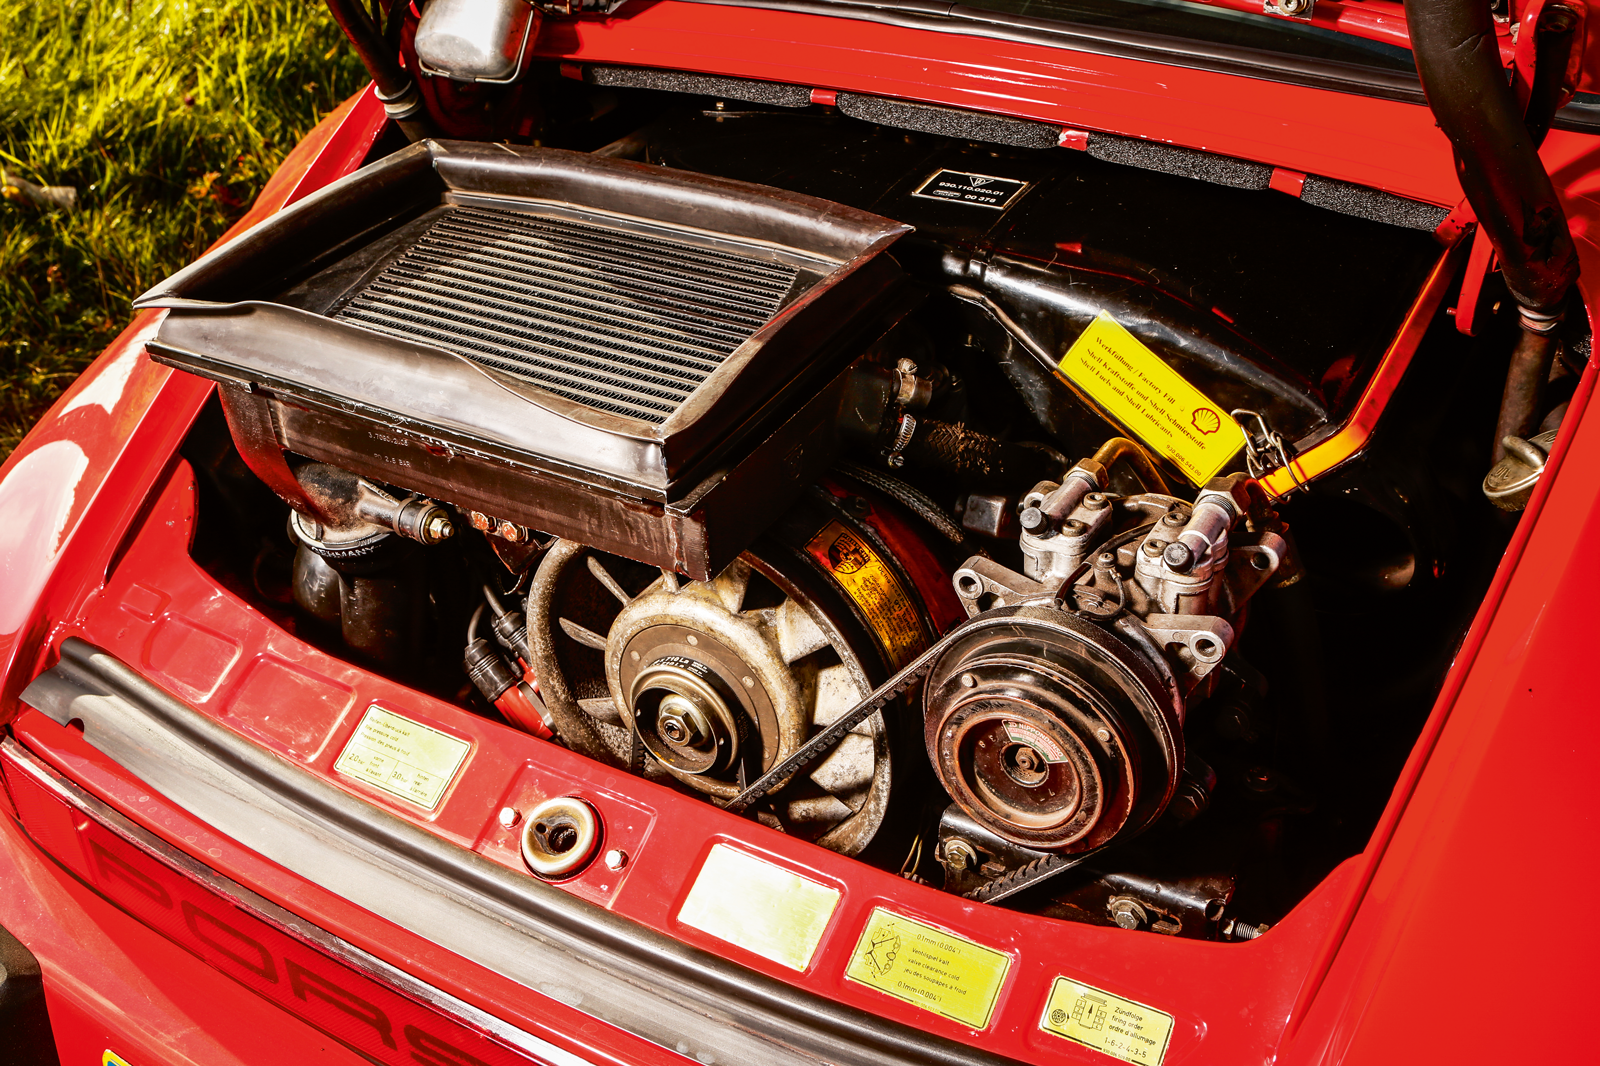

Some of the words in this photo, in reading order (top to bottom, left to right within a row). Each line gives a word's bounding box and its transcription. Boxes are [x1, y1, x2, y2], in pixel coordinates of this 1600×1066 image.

[1096, 337, 1133, 371] Werkfüllung
[1138, 372, 1161, 393] Factory
[1163, 393, 1175, 404] Fill
[1081, 358, 1095, 372] Shell
[1095, 371, 1111, 386] Fuels
[1112, 387, 1125, 396] and
[1126, 395, 1141, 410] Shell
[1141, 408, 1172, 437] Lubricants
[1087, 349, 1103, 363] Shell
[1103, 362, 1135, 390] Kraftstoffe
[1136, 390, 1149, 401] und
[1150, 400, 1165, 415] Shell
[1167, 414, 1205, 449] Schmierstoffe
[373, 729, 389, 738] pressure
[1018, 722, 1063, 757] NIPPONDENSO
[912, 948, 938, 961] Ventilspiel
[922, 964, 947, 976] clearance
[903, 968, 912, 976] jeu
[924, 976, 948, 988] soupapes
[954, 986, 966, 995] froid
[1114, 1007, 1143, 1021] Zündfolge
[1109, 1025, 1123, 1033] ordre
[1112, 1015, 1126, 1026] firing
[1128, 1021, 1144, 1031] order
